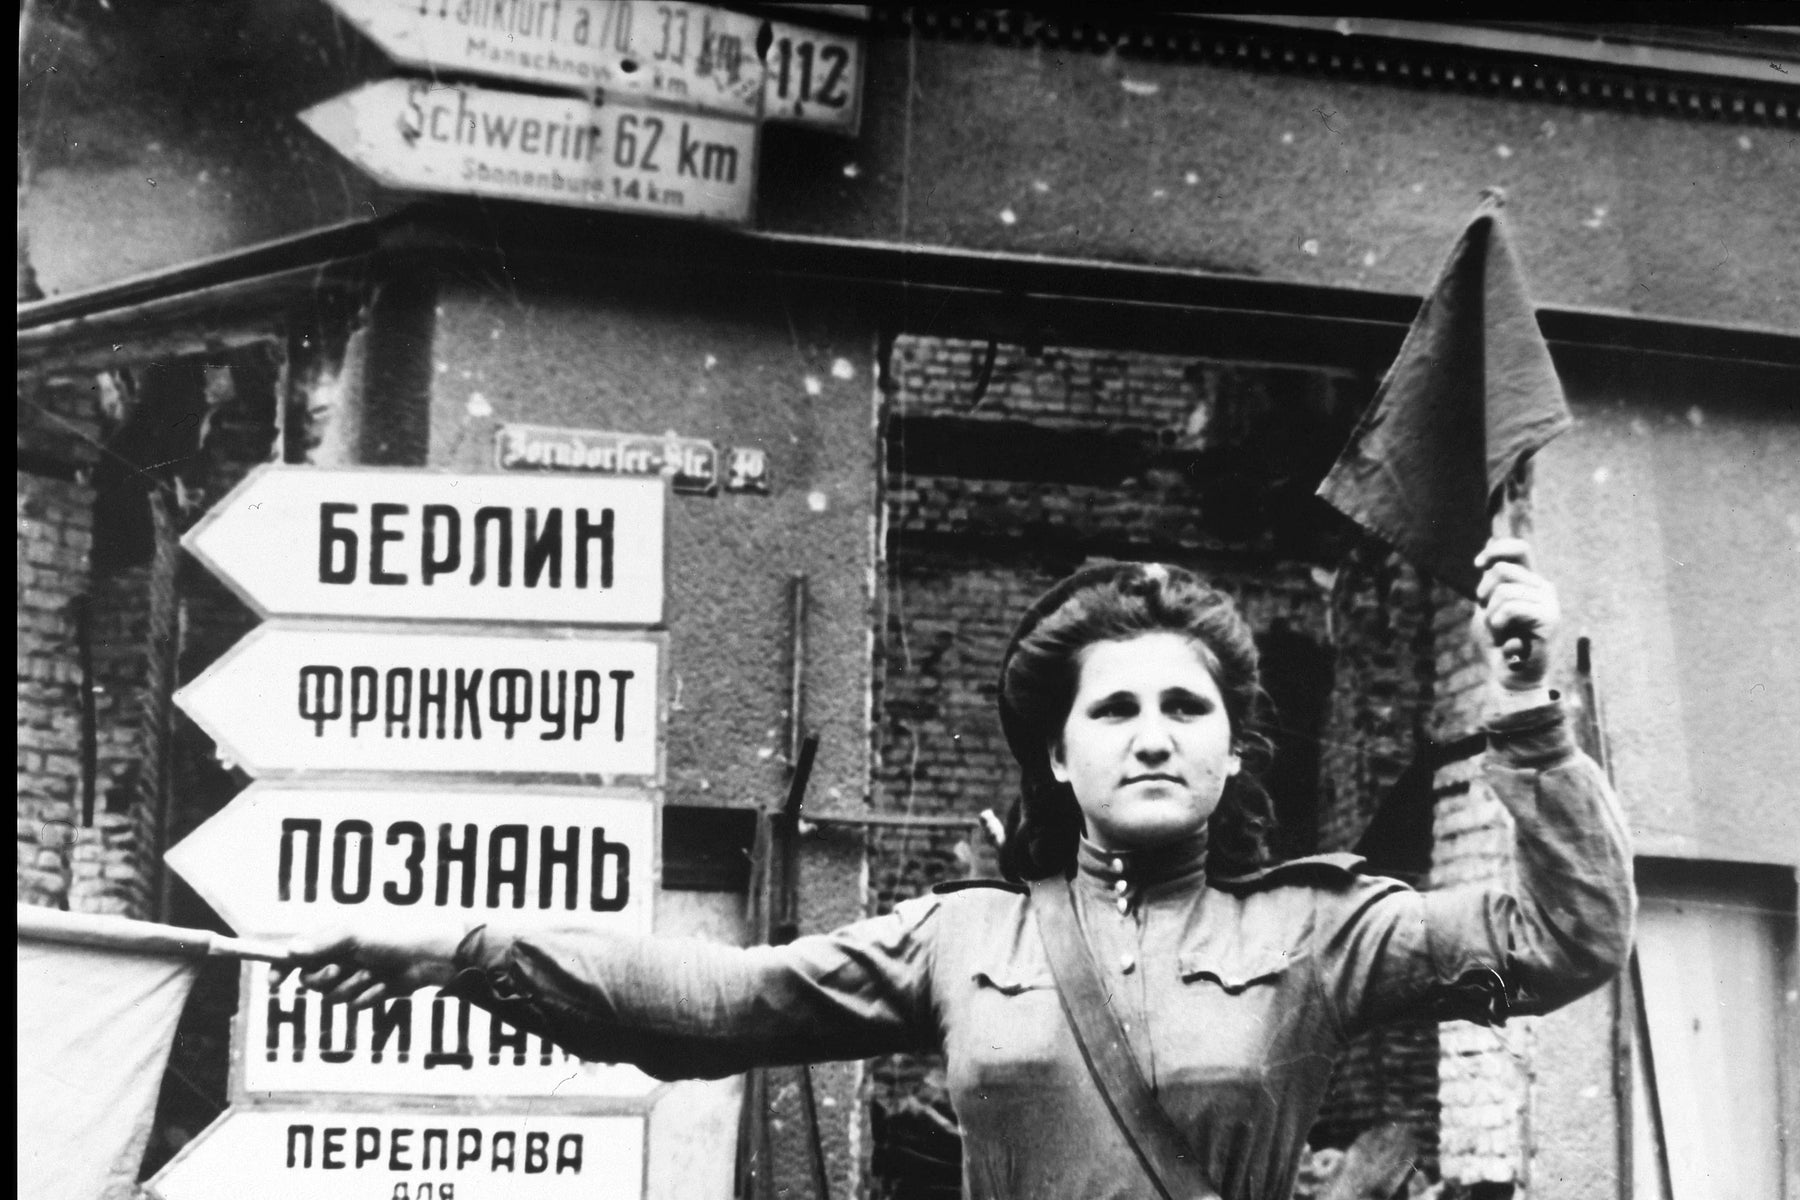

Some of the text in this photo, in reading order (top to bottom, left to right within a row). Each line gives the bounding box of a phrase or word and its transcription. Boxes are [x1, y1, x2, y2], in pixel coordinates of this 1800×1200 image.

[777, 37, 849, 109] 112
[398, 82, 738, 184] Schwerin 62 km
[613, 176, 641, 200] 14
[648, 180, 685, 206] km
[318, 501, 616, 590] БЕРЛИН
[298, 664, 636, 743] ФРАНКФУРТ
[277, 817, 631, 913] ПОЗНАНЬ
[286, 1124, 585, 1175] ПЕРЕПРАВА
